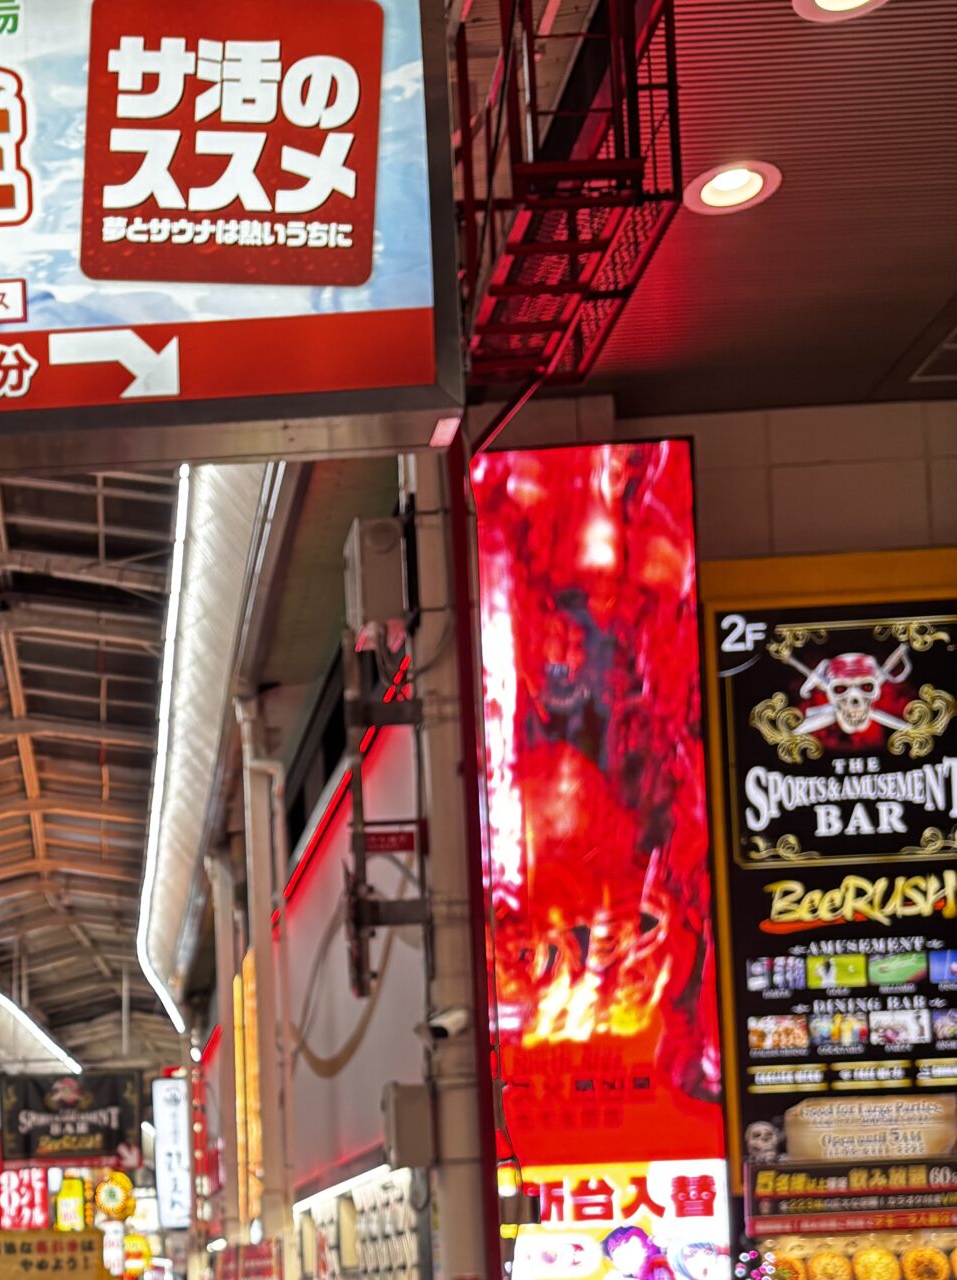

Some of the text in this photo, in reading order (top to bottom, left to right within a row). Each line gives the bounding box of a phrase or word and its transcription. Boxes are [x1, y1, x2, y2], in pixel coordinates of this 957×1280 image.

[108, 36, 360, 128] サ活の
[102, 128, 356, 213] ススメ
[102, 216, 353, 248] 夢とサウナは熱いうちに
[720, 613, 767, 653] 2F
[831, 757, 880, 775] THE
[814, 801, 908, 838] BAR
